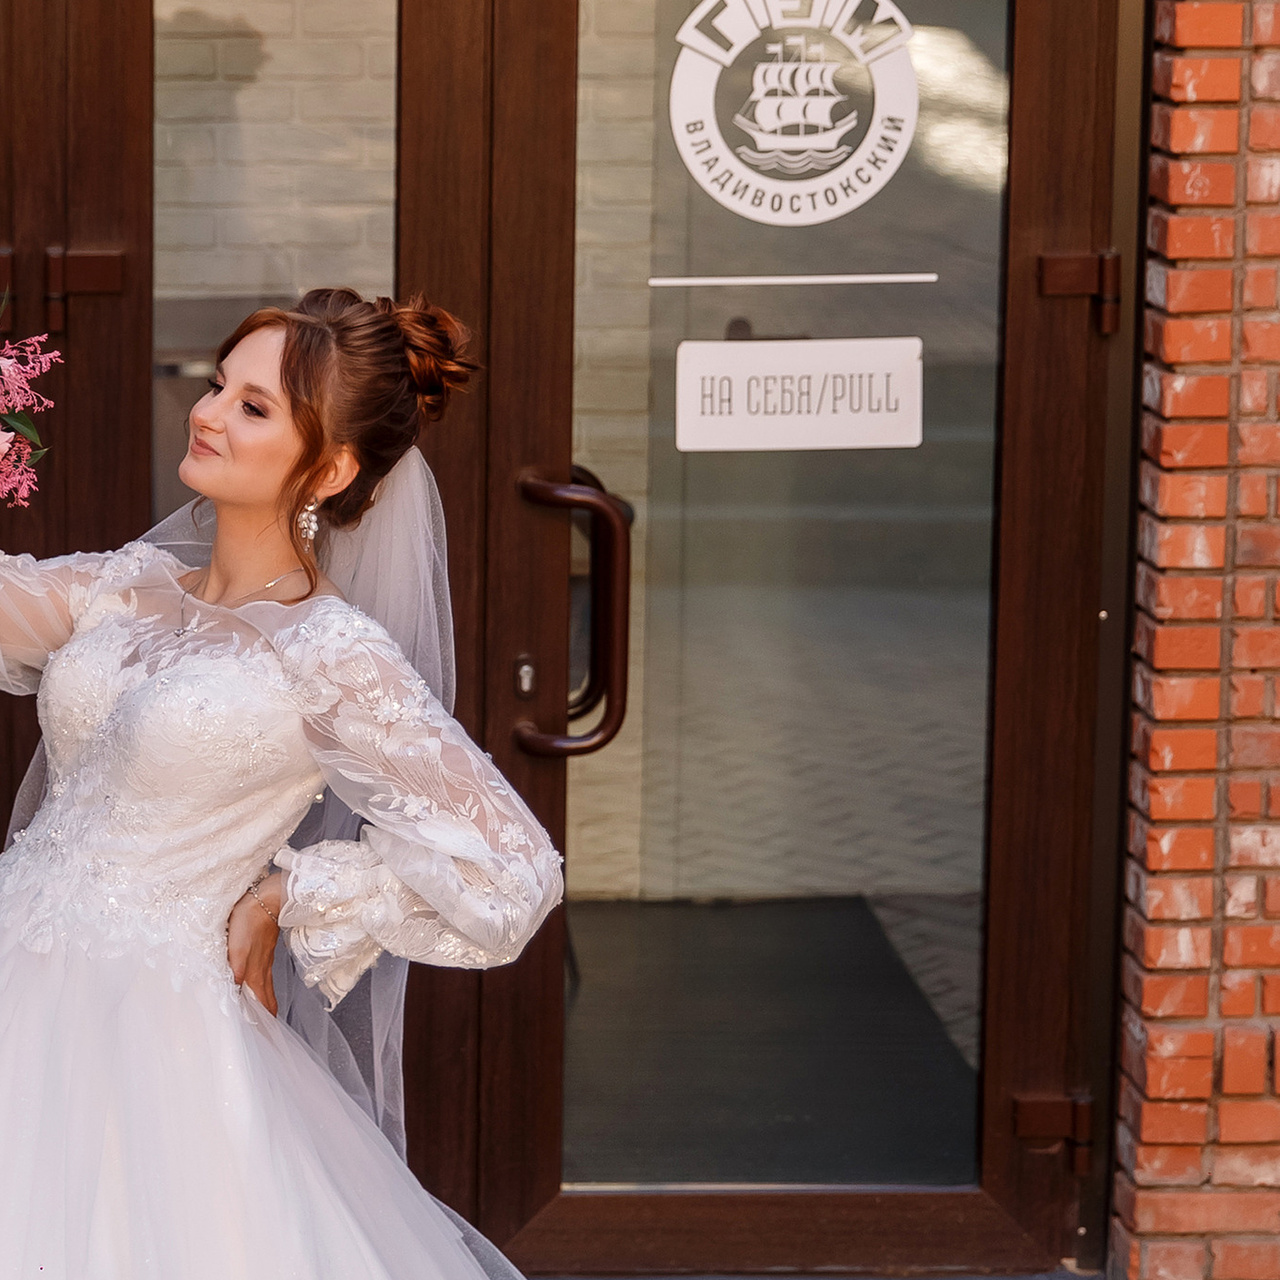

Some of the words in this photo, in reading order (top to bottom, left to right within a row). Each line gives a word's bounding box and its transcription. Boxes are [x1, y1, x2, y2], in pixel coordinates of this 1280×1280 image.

[684, 115, 906, 215] ВЛАДИВОСТОКСКИЙ
[699, 374, 734, 417] НА
[746, 371, 899, 416] СЕБЯ/PULL
